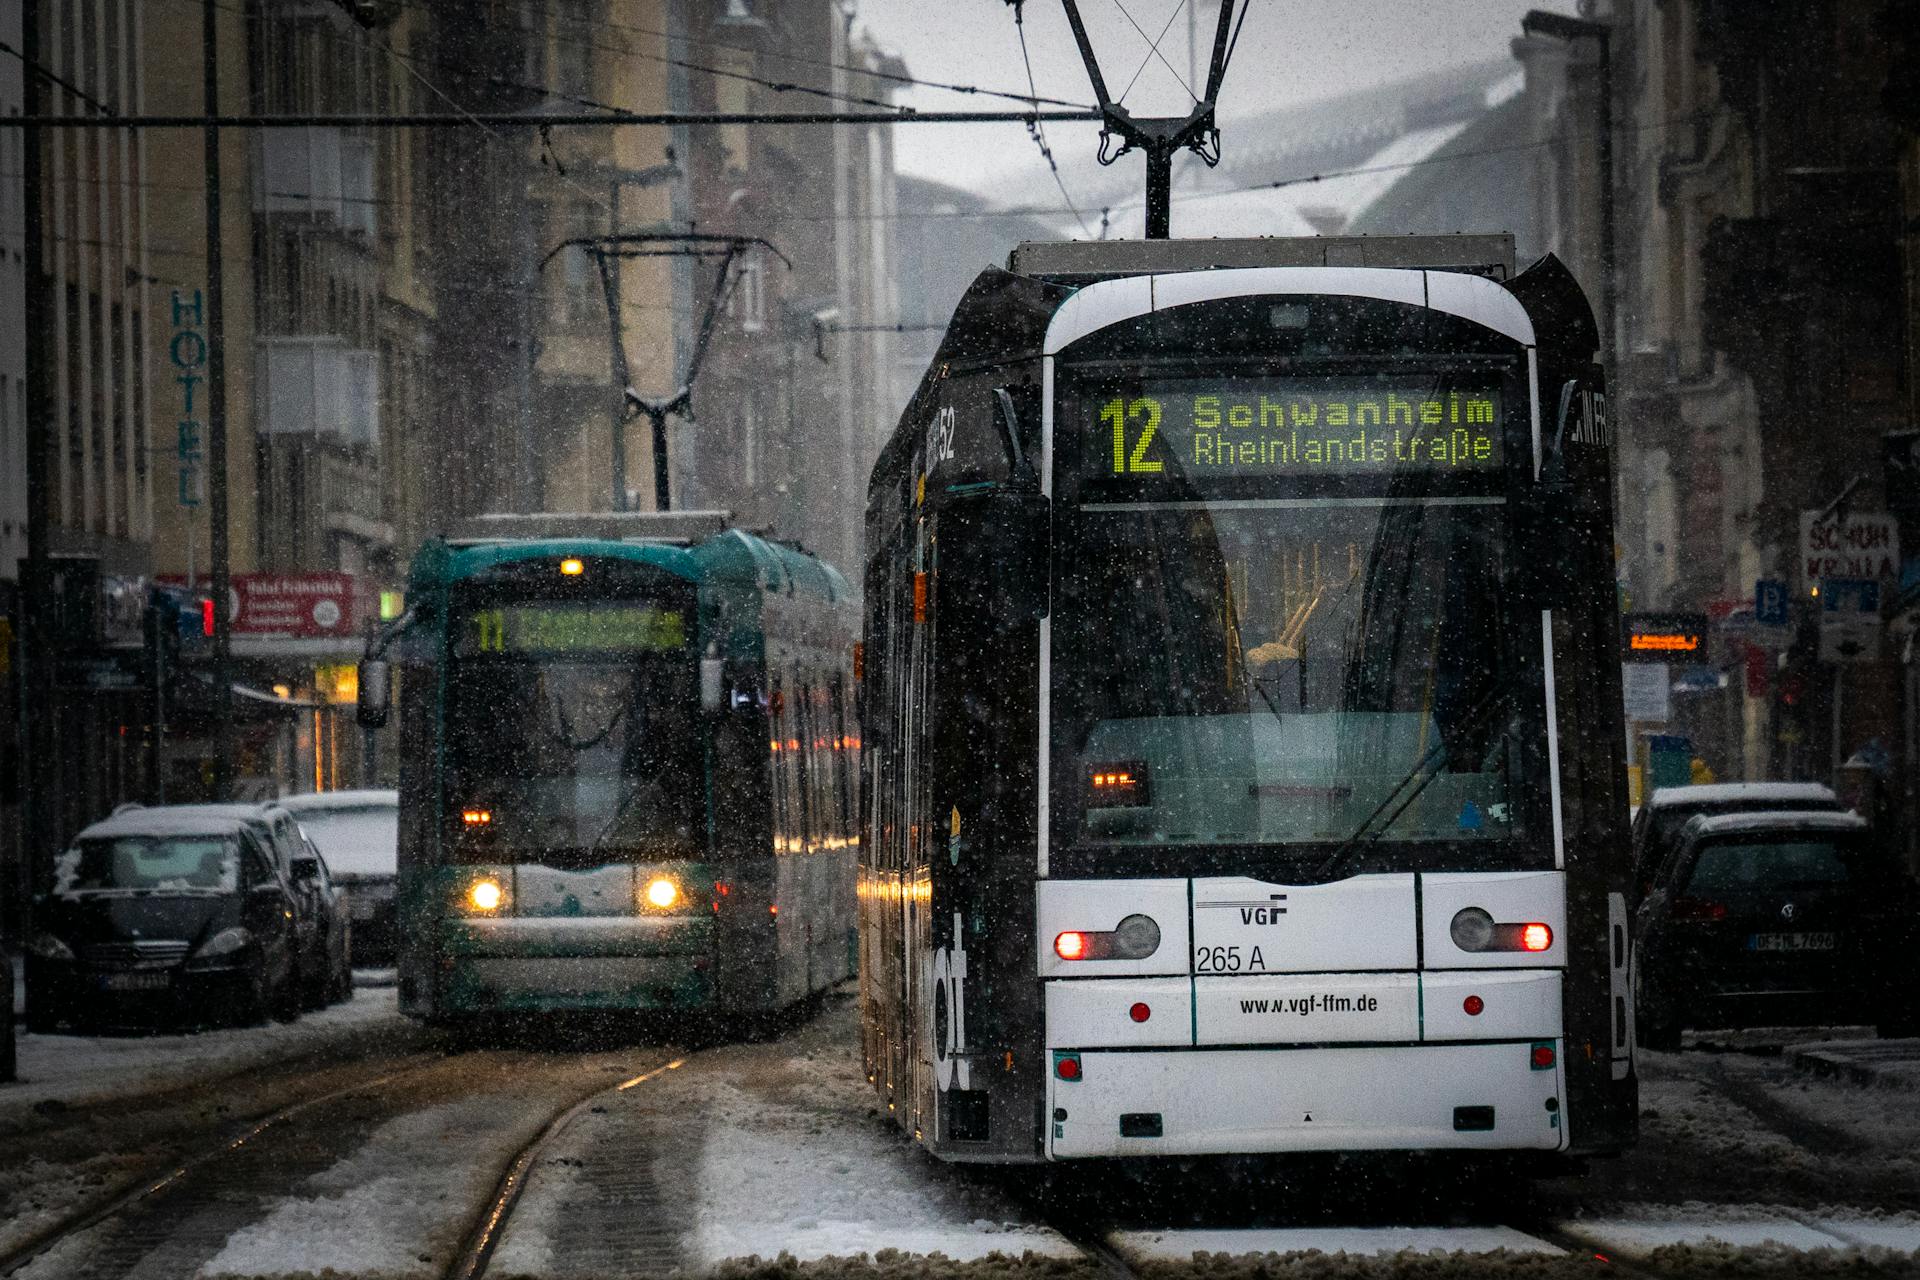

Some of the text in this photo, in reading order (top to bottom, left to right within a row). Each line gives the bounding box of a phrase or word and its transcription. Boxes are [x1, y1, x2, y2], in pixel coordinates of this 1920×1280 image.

[169, 288, 206, 506] HOTEL
[939, 406, 955, 461] 52
[1101, 393, 1493, 473] 12 Schwanheim
[1194, 428, 1491, 465] Rheinlandstraße
[474, 609, 504, 652] 11
[1240, 894, 1287, 925] VGF
[1197, 945, 1266, 971] 265 A
[1240, 994, 1378, 1016] www.vgf-ffm.de
